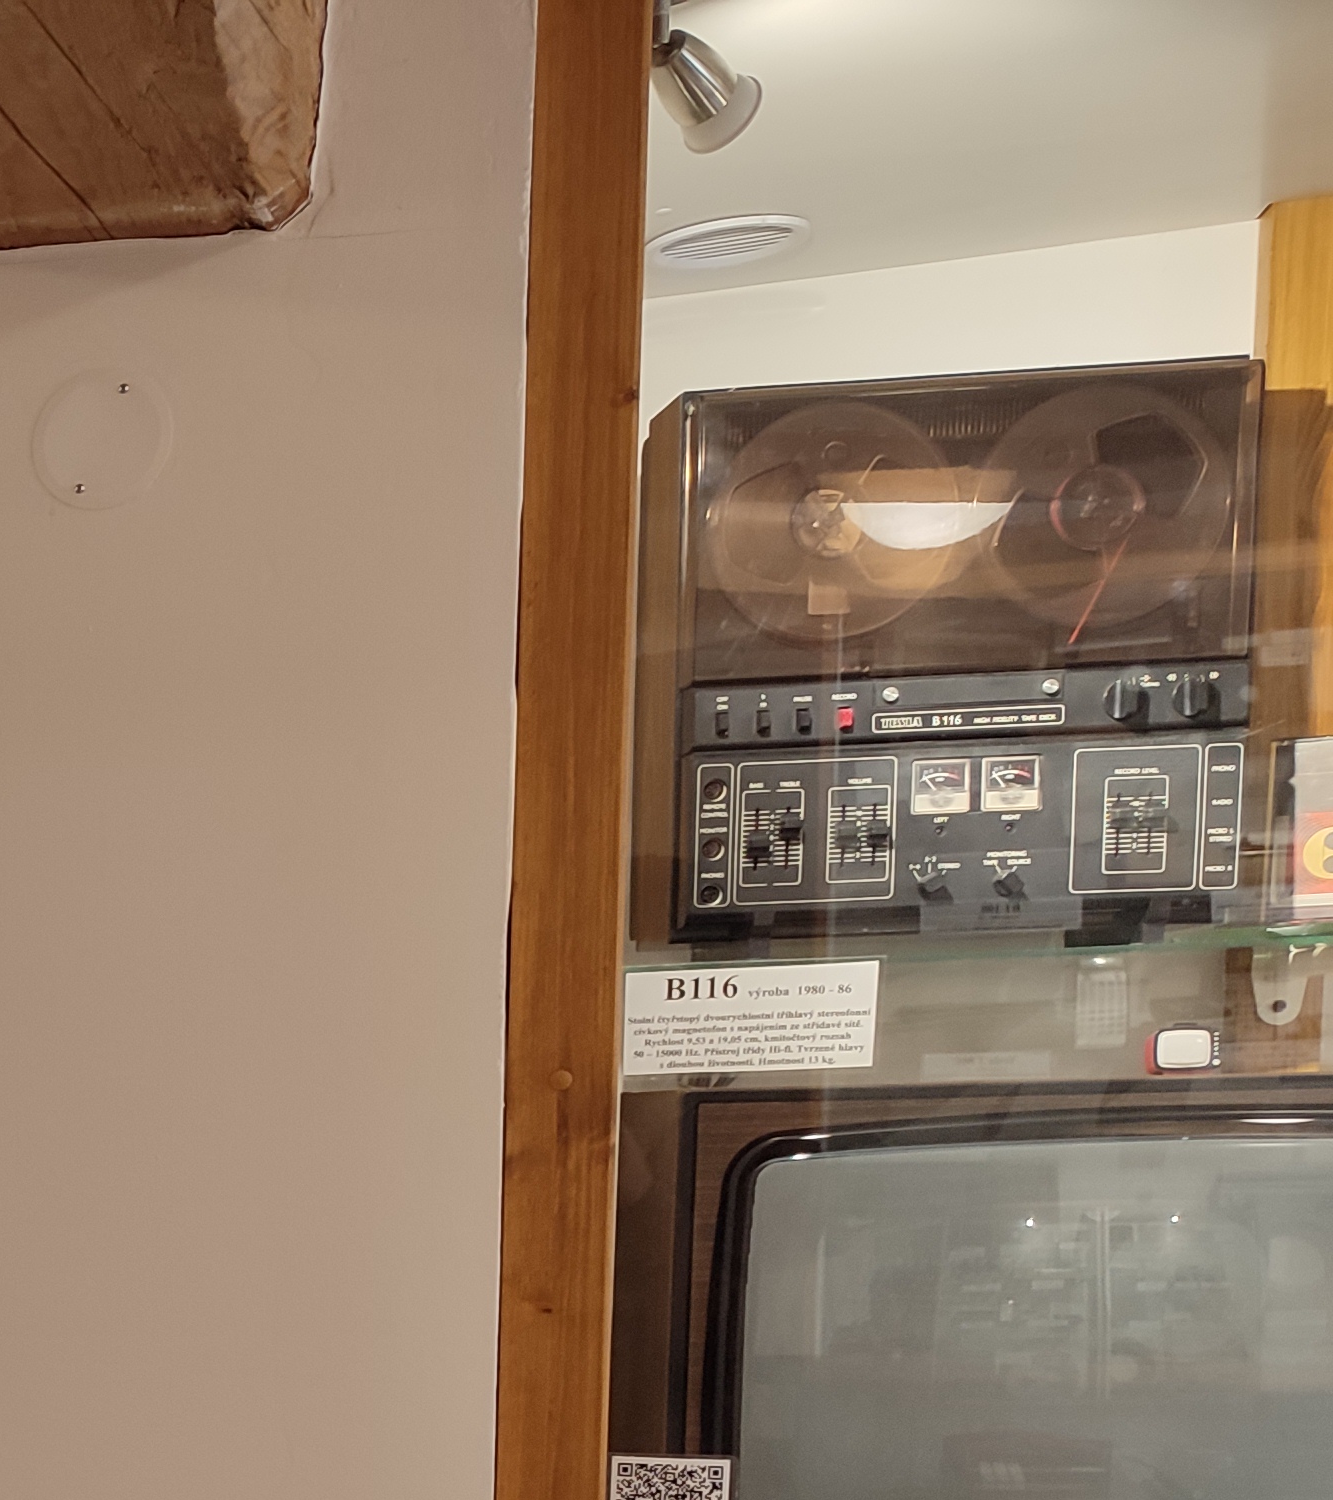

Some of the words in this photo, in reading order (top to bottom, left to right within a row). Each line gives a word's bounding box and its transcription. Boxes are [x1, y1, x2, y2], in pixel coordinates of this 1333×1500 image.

[881, 716, 922, 729] TESLA
[932, 715, 941, 726] B
[942, 715, 962, 726] 116
[665, 975, 739, 1001] B116
[748, 987, 790, 999] výroba
[798, 985, 825, 995] 1980
[837, 984, 852, 994] 86
[644, 1037, 684, 1047] Rychlost
